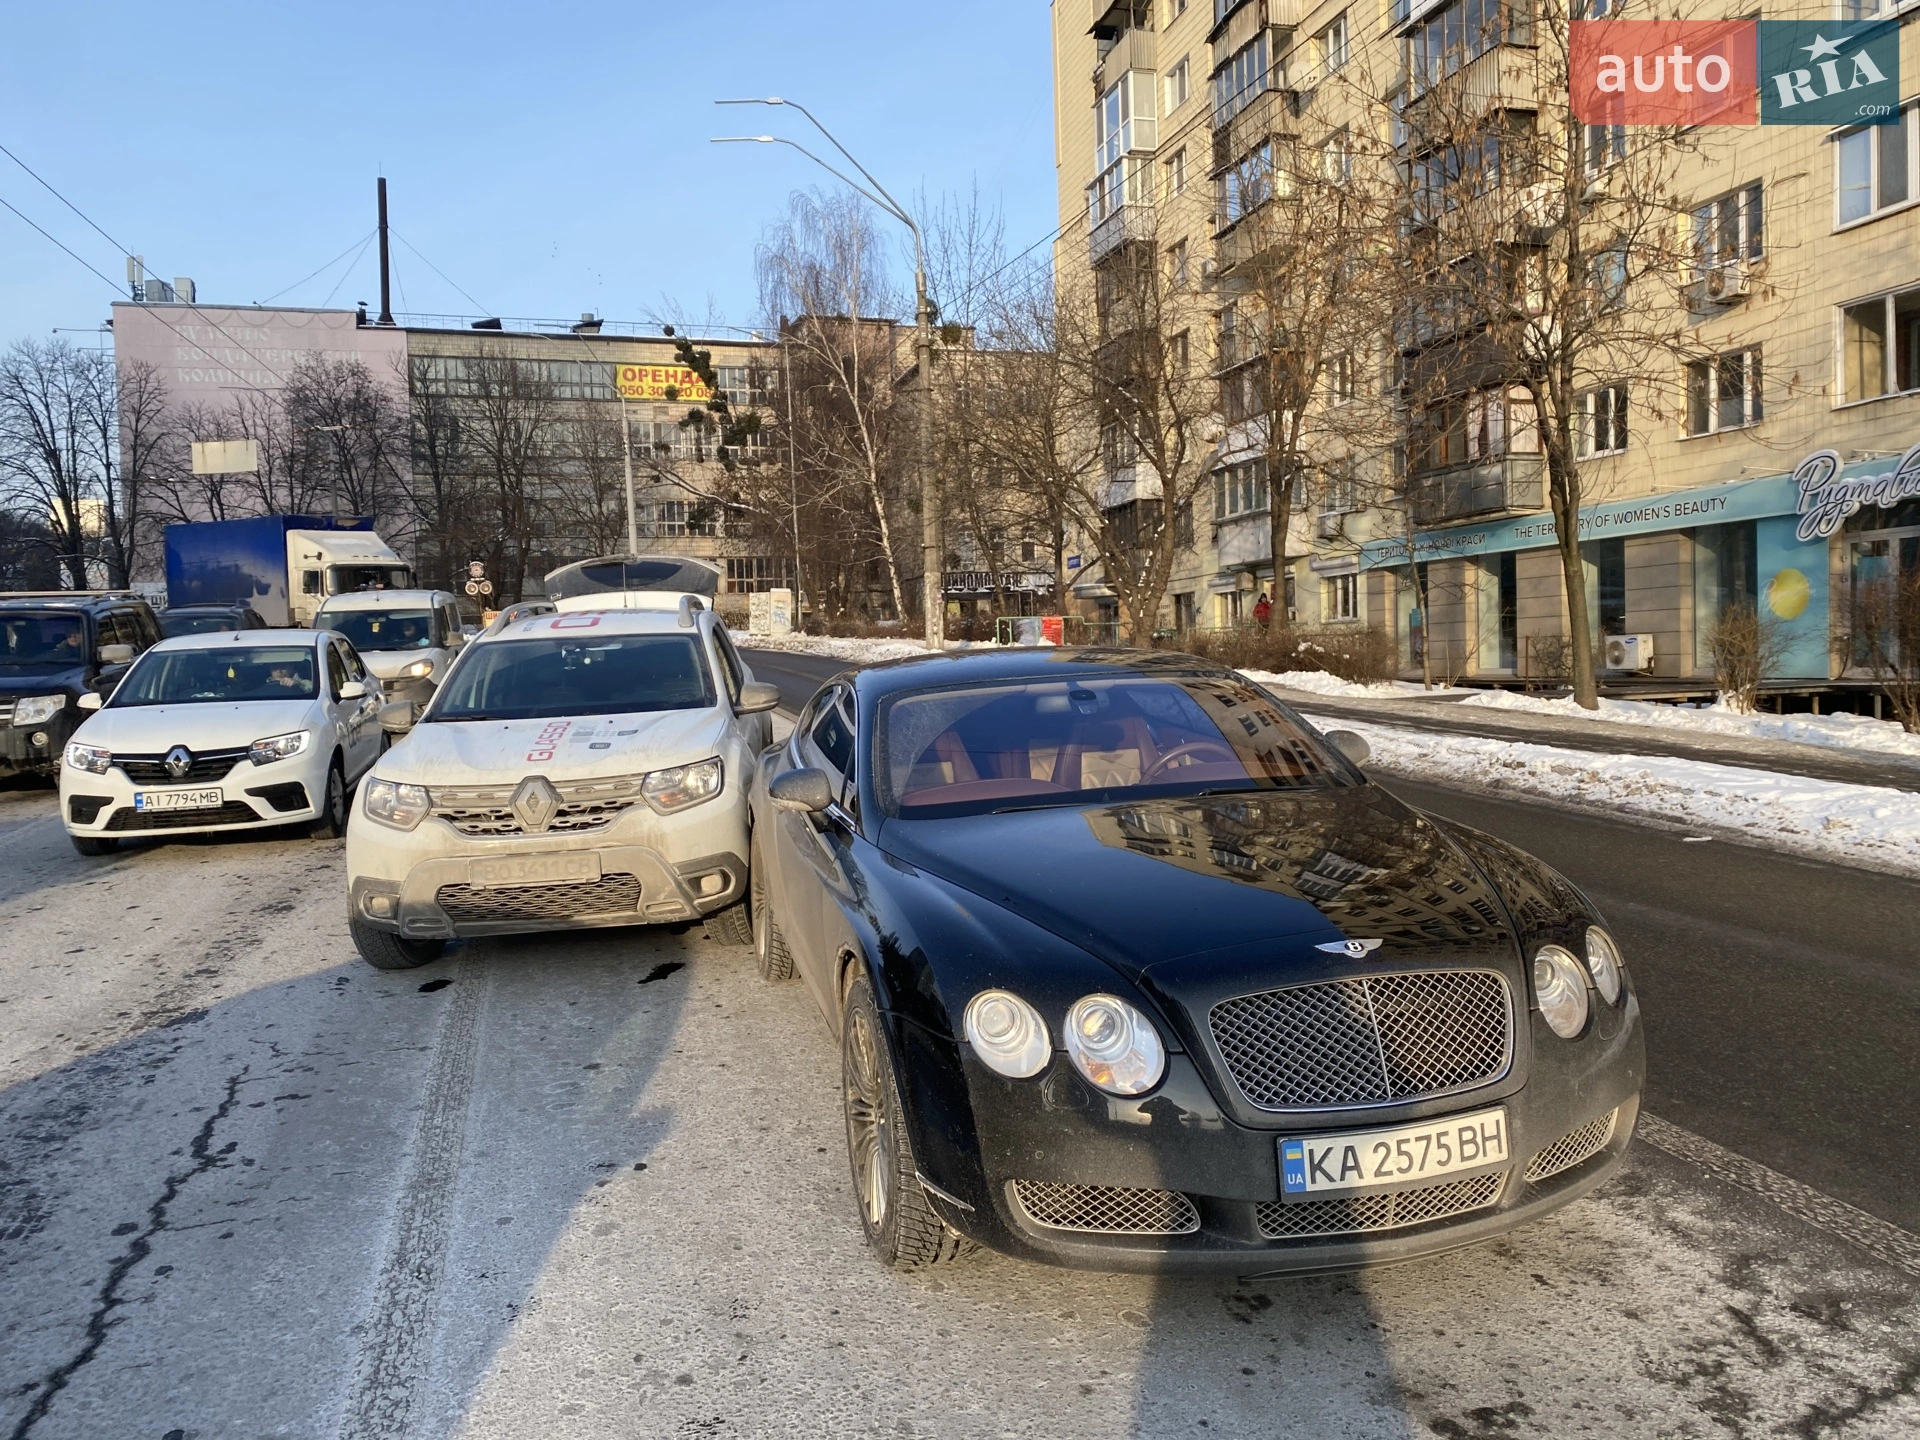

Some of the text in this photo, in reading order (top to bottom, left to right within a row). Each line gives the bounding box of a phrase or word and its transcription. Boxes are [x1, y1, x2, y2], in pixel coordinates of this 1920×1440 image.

[620, 385, 644, 396] 050
[648, 386, 673, 397] 30
[1514, 526, 1533, 540] THE
[1595, 514, 1610, 528] OF
[1613, 505, 1671, 526] WOMEN'S
[1674, 497, 1728, 517] BEAUTY
[1456, 533, 1486, 548] КРАСИ
[526, 720, 572, 762] GLASSO
[145, 791, 219, 807] AI 7794 MB
[1308, 1119, 1503, 1185] KA 2575 BH
[1287, 1173, 1304, 1185] UA
